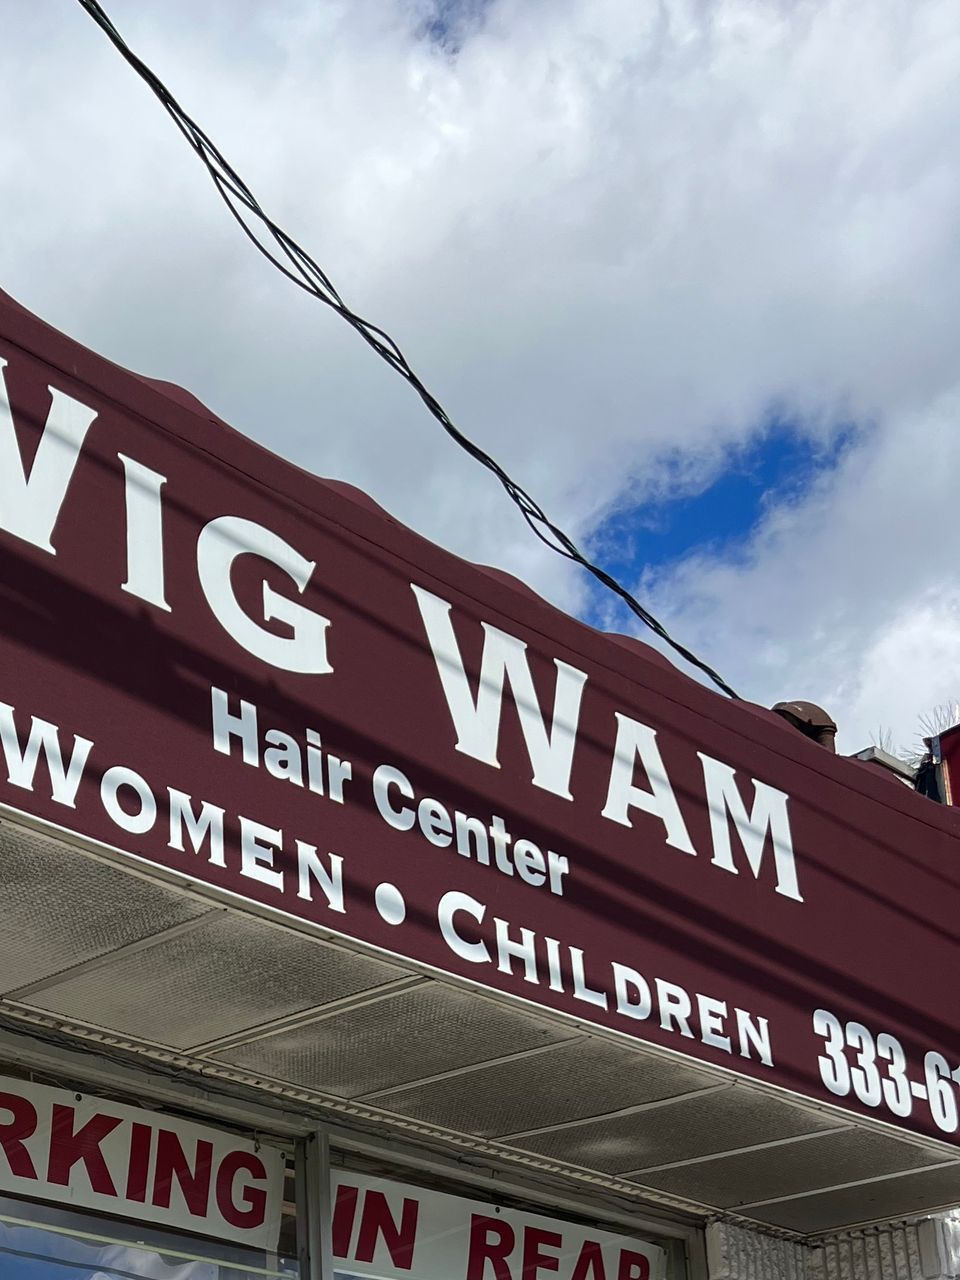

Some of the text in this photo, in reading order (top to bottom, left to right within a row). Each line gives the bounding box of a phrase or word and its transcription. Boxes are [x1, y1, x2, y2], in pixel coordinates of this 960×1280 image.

[211, 685, 570, 896] Hair Center
[410, 583, 804, 903] WAM
[438, 890, 775, 1067] CHILDREN
[813, 1009, 960, 1133] 333-6
[331, 1184, 420, 1270] IN
